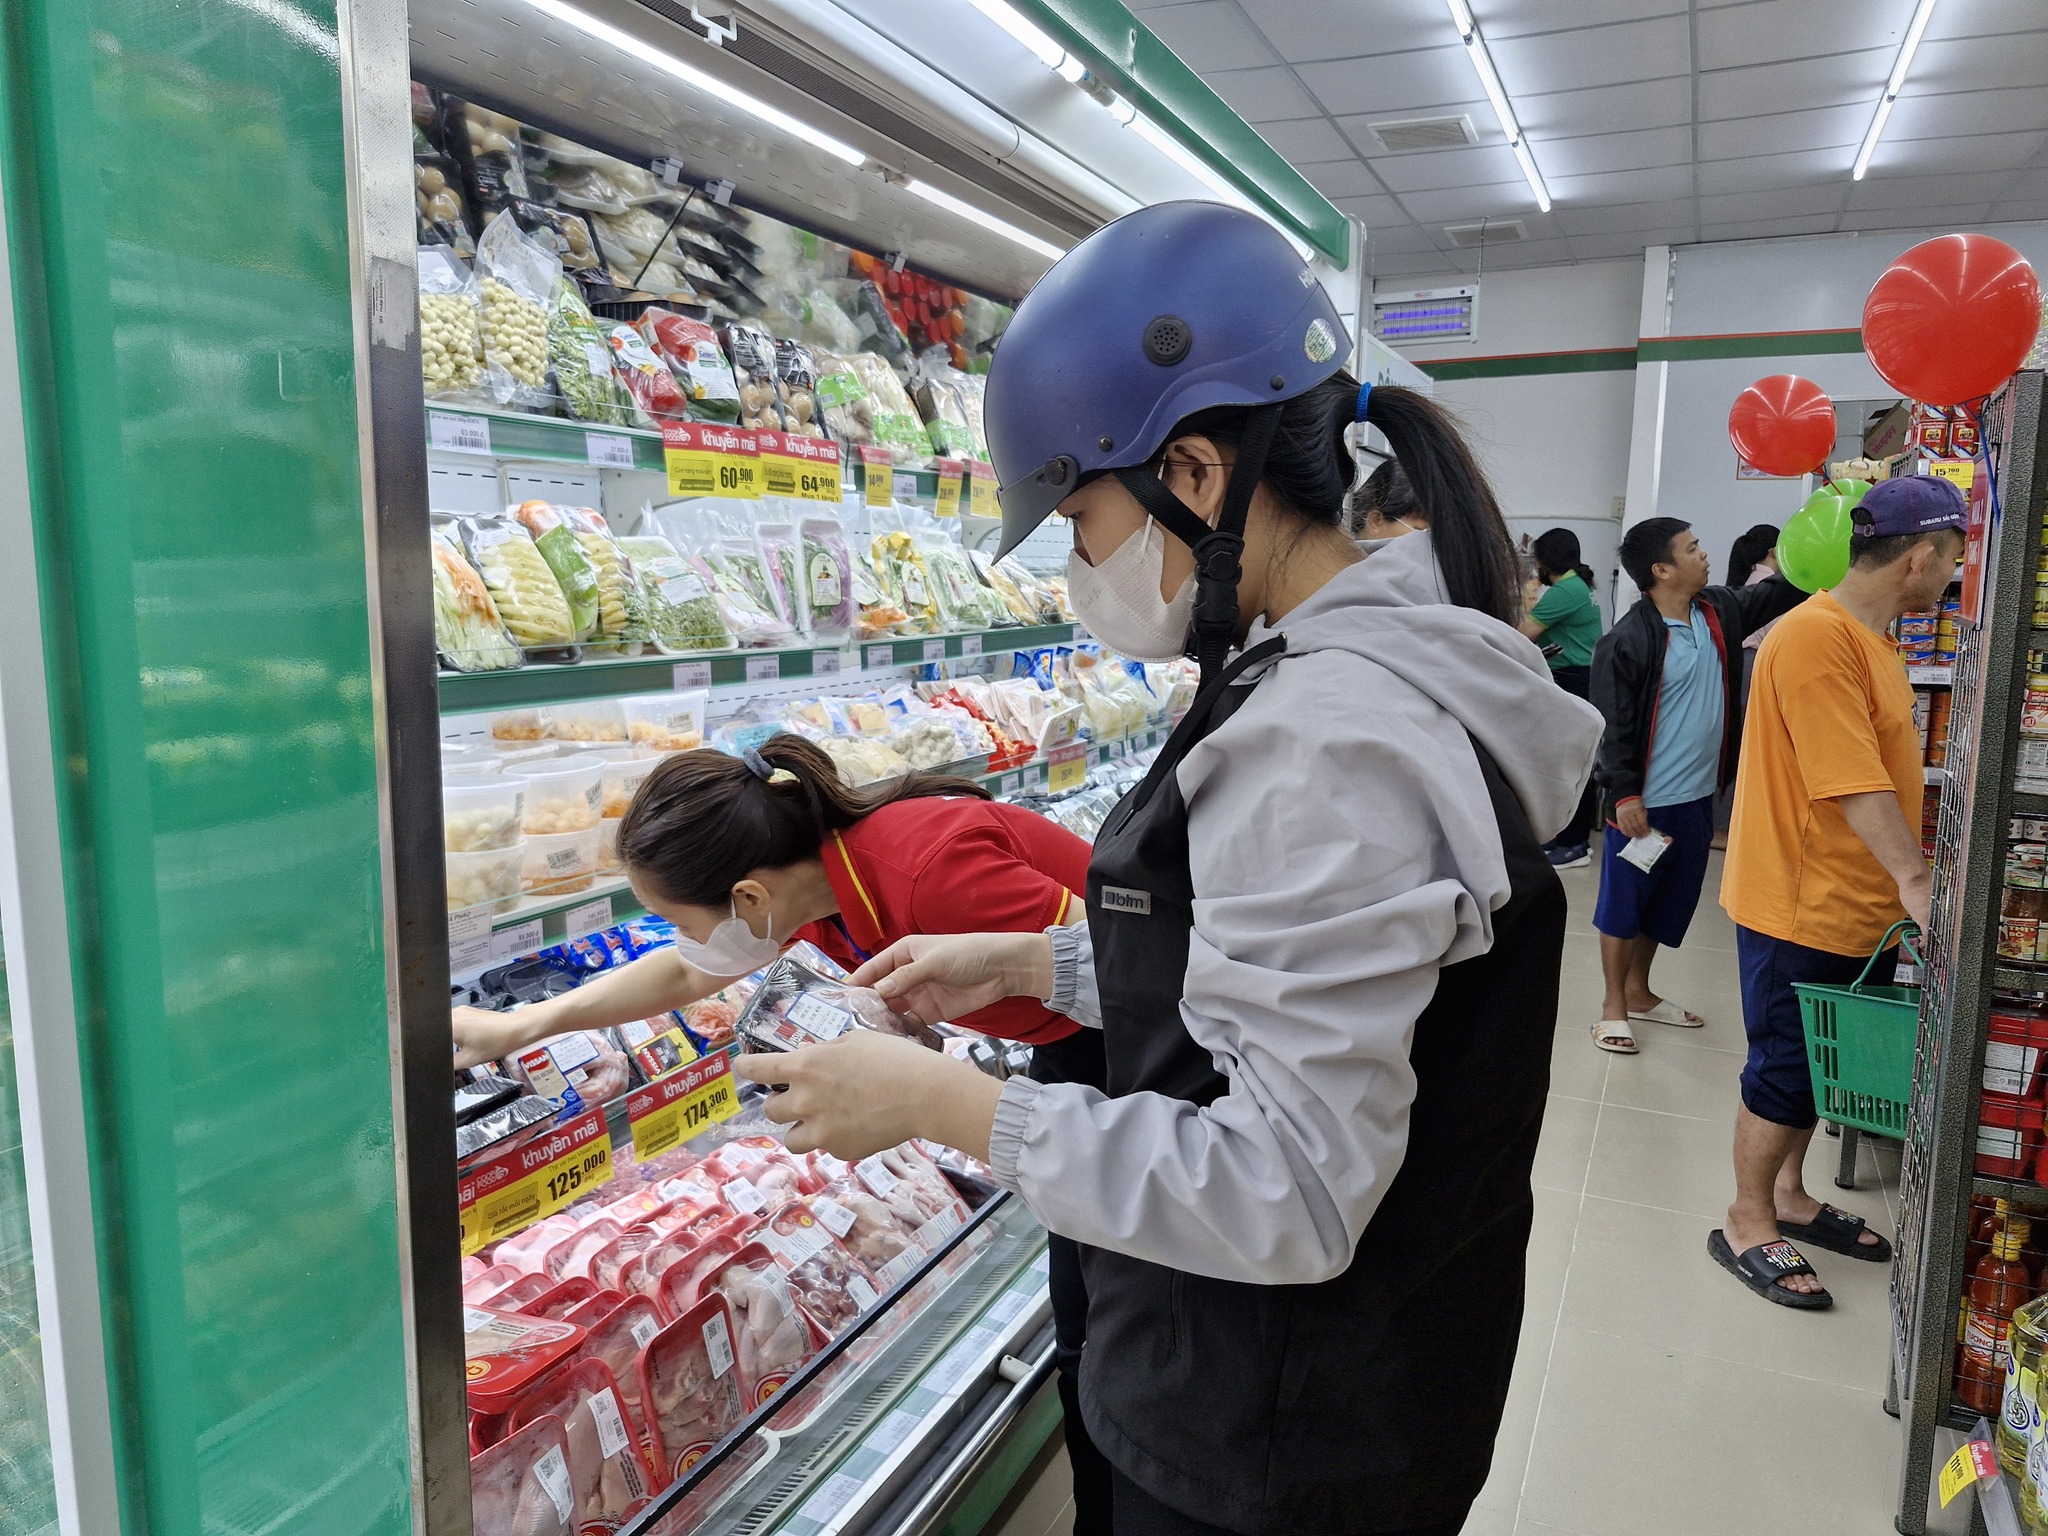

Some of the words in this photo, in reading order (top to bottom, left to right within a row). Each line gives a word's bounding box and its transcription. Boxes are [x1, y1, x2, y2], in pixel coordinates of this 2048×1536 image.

[741, 435, 757, 452] mãi
[1872, 425, 1897, 454] Happy
[820, 446, 838, 460] mãi
[720, 466, 754, 490] 60.900
[801, 474, 836, 493] 64.900
[1919, 516, 1942, 526] SUBARU
[524, 1053, 550, 1069] VISSAN
[705, 1056, 725, 1079] mãi
[683, 1087, 728, 1129] 174.300
[573, 1117, 599, 1142] mãi
[546, 1149, 606, 1202] 125.000
